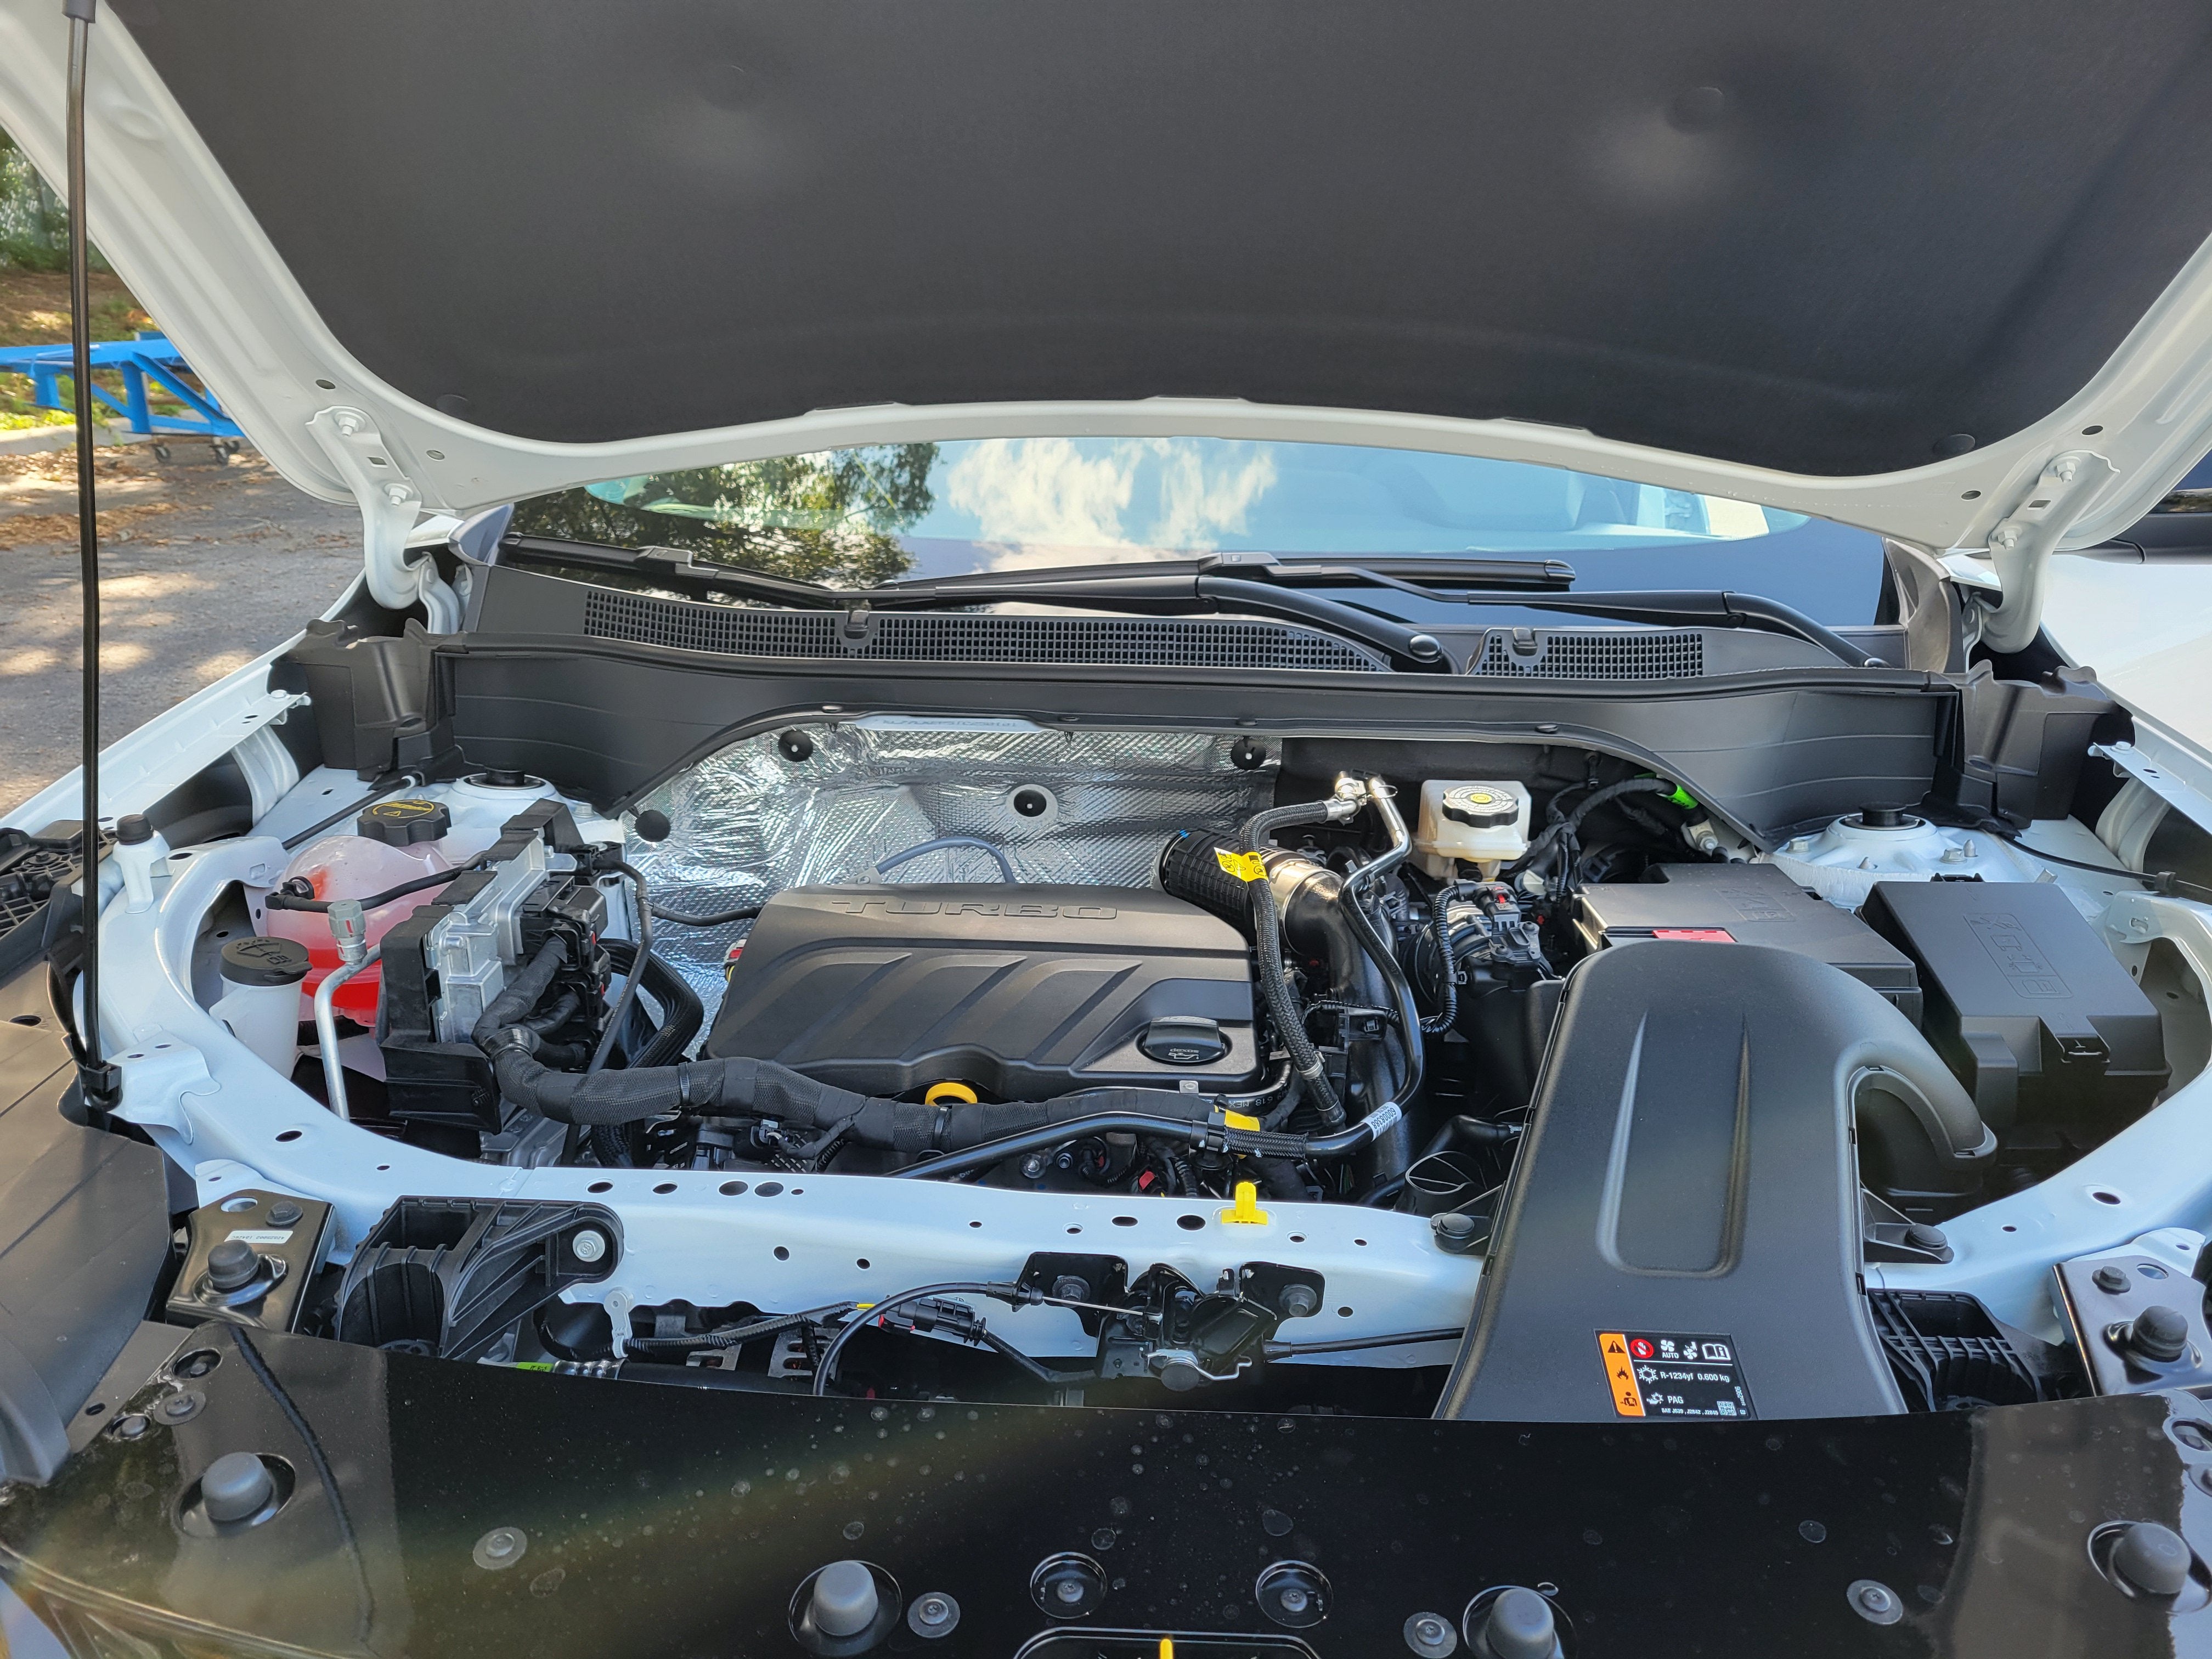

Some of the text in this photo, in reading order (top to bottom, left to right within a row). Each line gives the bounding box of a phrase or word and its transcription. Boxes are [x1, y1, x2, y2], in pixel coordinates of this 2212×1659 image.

[831, 900, 1118, 920] TURBO
[1229, 1100, 1250, 1108] MEX
[1371, 1107, 1397, 1130] 60008388
[1660, 1371, 1730, 1383] R-1234yf 0.600 kg
[1667, 1395, 1684, 1404] PAG
